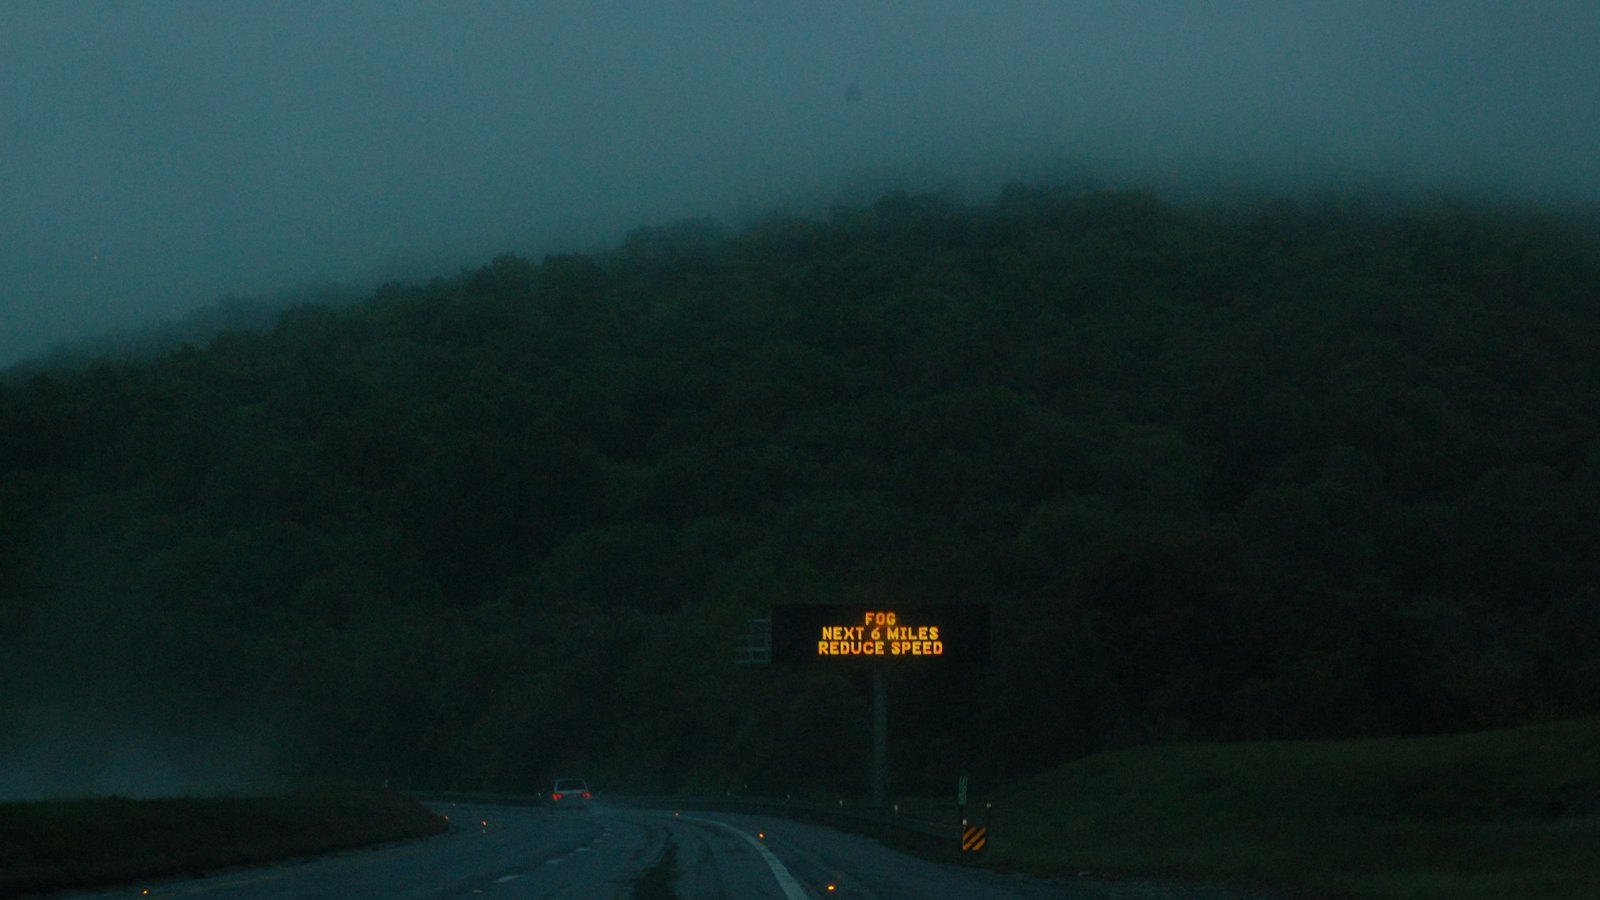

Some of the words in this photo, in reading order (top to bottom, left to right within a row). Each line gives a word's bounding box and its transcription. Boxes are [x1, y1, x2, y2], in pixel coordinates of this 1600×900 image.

[865, 612, 896, 626] FOG
[822, 626, 864, 640] NEXT
[871, 627, 880, 640] 6
[886, 626, 939, 640] MILES
[818, 641, 885, 655] REDUCE
[891, 641, 943, 655] SPEED
